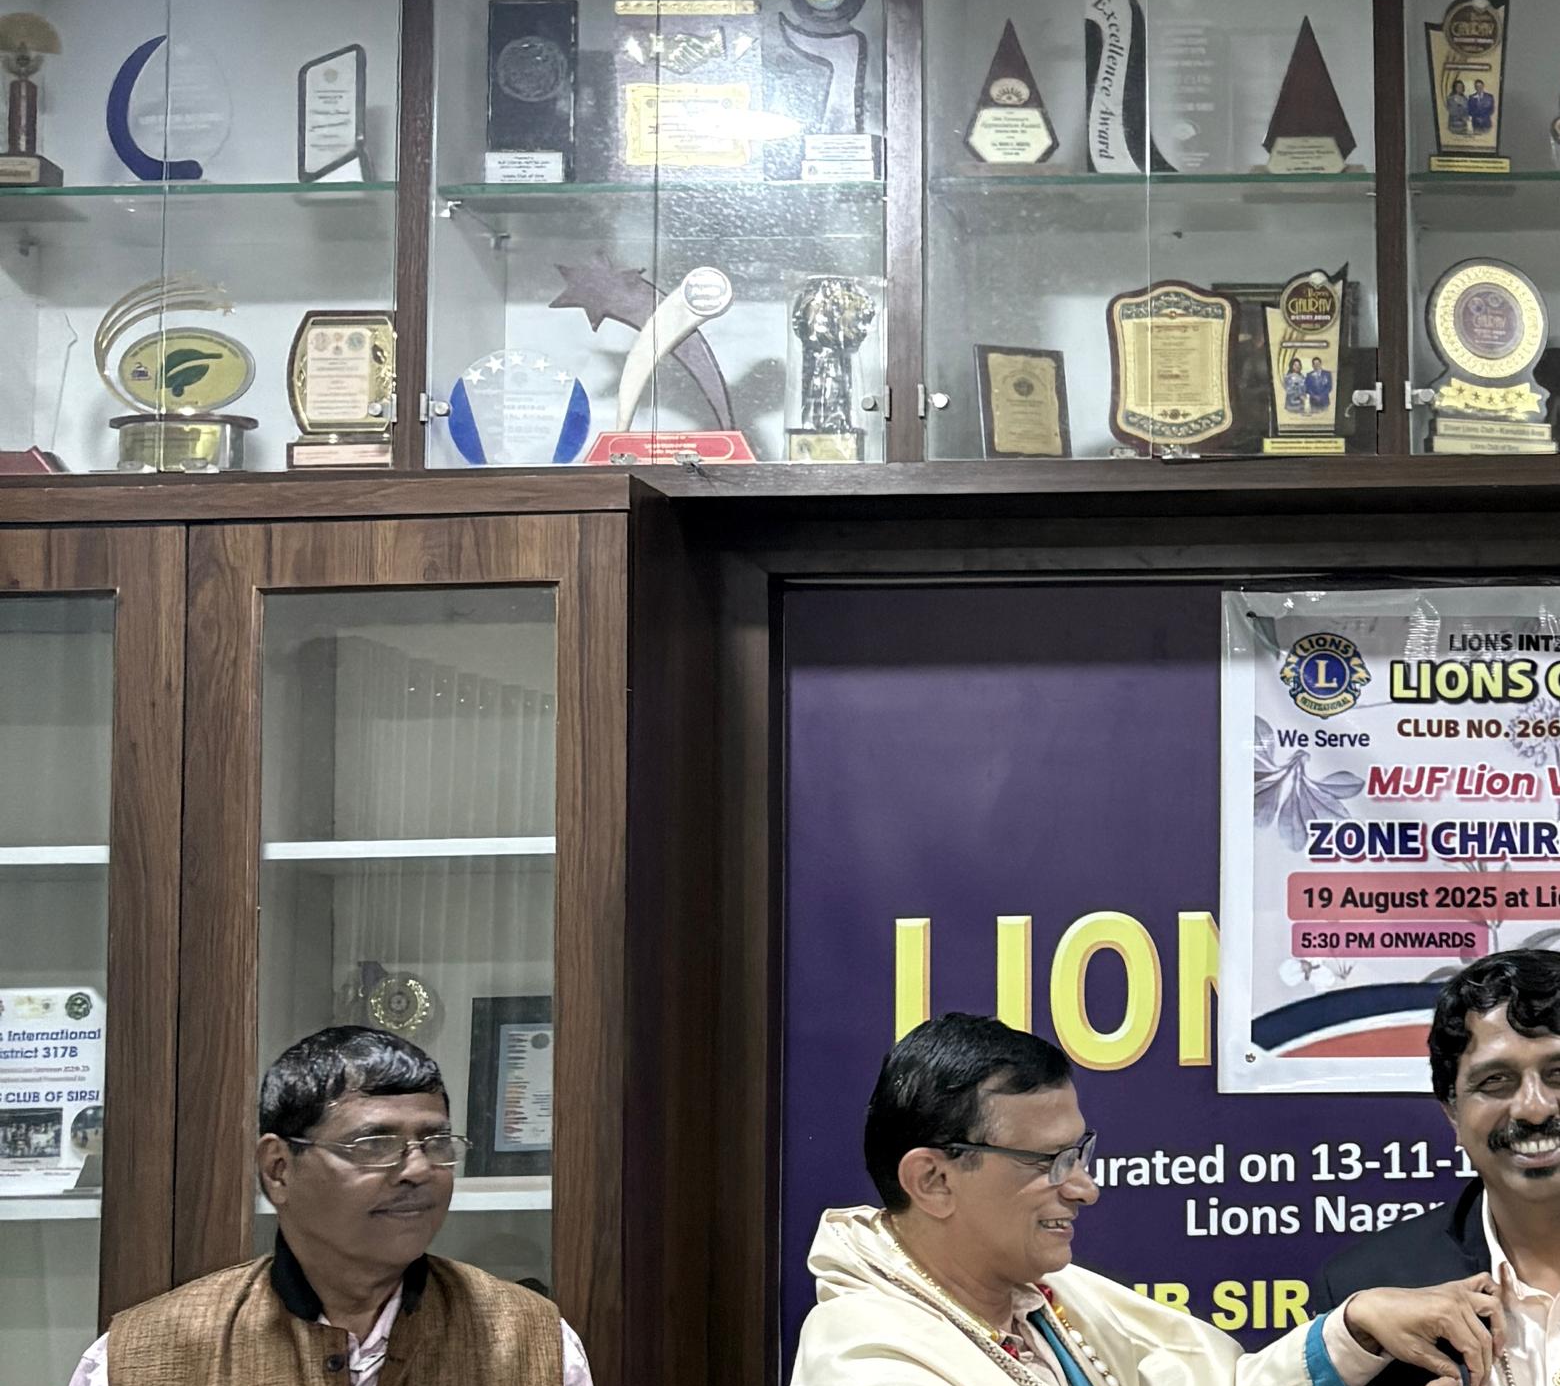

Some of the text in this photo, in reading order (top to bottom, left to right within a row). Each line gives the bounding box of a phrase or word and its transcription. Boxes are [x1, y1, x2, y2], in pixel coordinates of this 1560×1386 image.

[1096, 102, 1116, 160] Award
[1299, 636, 1352, 655] LIONS
[1449, 633, 1514, 652] LIONS
[1390, 660, 1538, 703] LIONS
[1277, 729, 1371, 747] We Serve
[1397, 718, 1461, 738] CLUB
[1466, 718, 1511, 739] NO.
[1367, 765, 1450, 799] MJF
[1455, 763, 1536, 798] Lion
[1308, 820, 1422, 857] ZONE
[1302, 886, 1334, 910] 19
[1340, 886, 1429, 914] August
[1434, 886, 1498, 909] 2025
[1504, 888, 1529, 909] at
[1300, 931, 1477, 950] 5:30 PM ONWARDS
[7, 1027, 102, 1043] International
[5, 1089, 100, 1104] CLUB OF SIRSI
[1239, 1152, 1296, 1184] on
[1186, 1197, 1300, 1237] Lions
